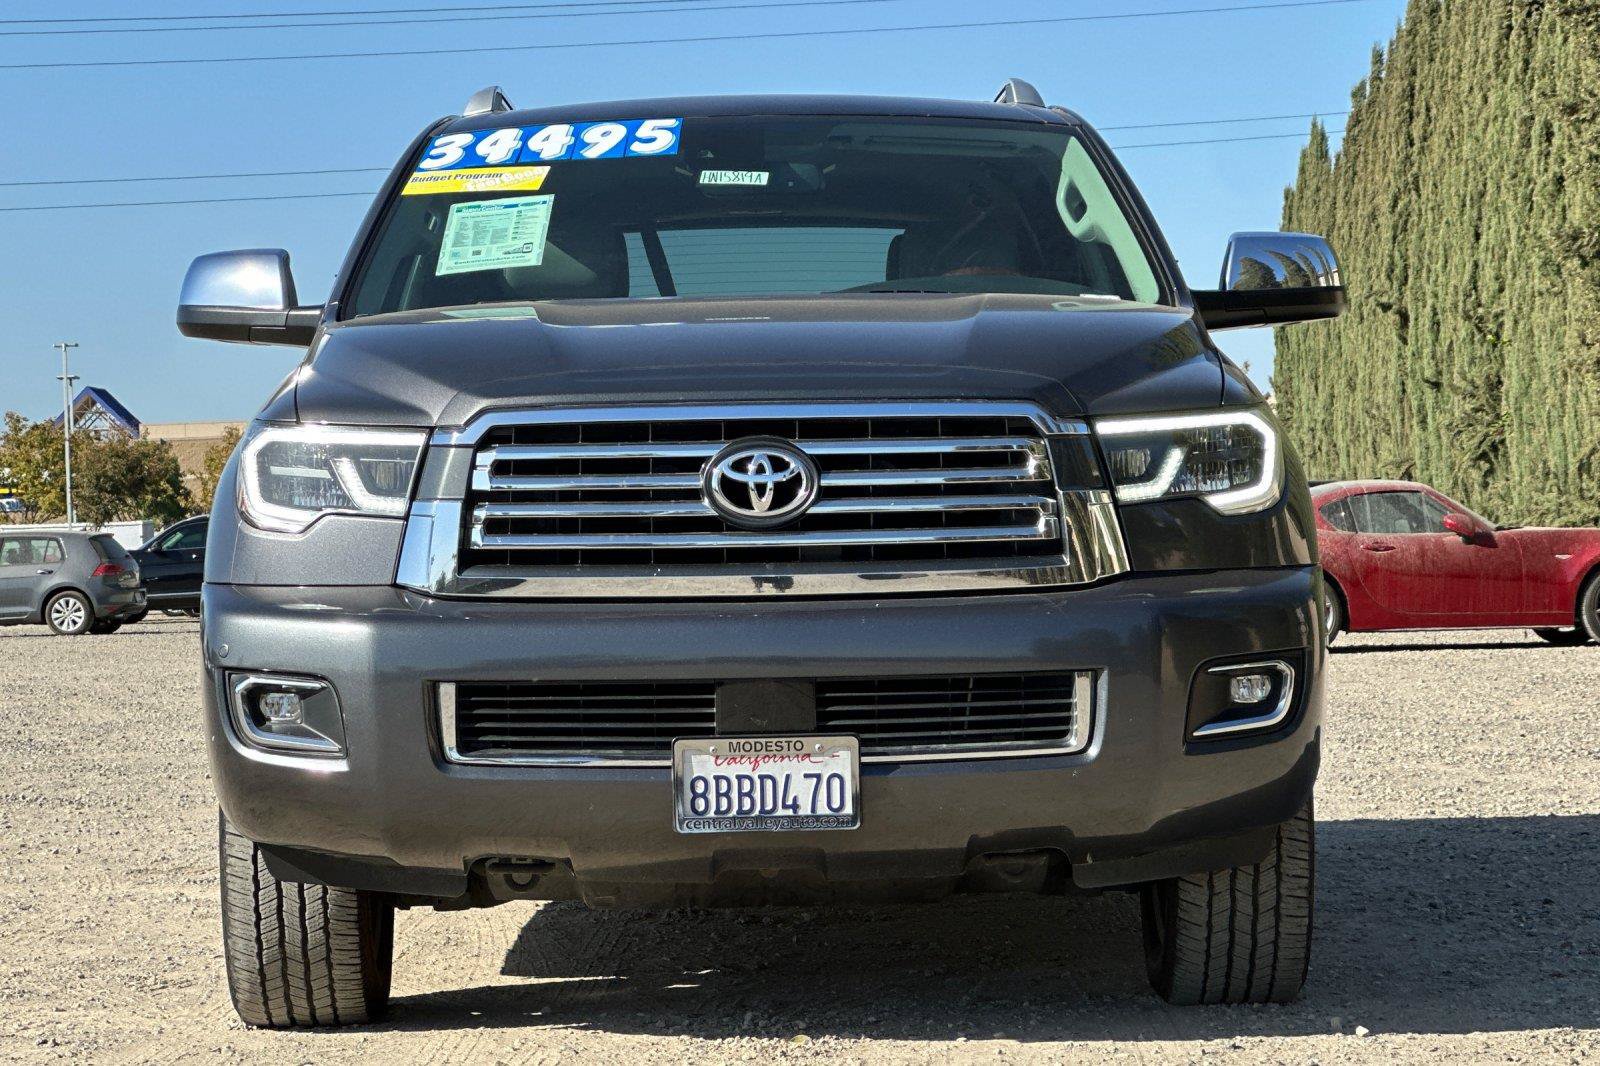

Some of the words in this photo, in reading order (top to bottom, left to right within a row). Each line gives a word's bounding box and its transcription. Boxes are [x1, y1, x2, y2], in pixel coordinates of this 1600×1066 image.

[419, 119, 680, 170] 34495
[411, 174, 452, 183] Budget
[454, 172, 503, 180] Program
[728, 740, 804, 753] MODESTO
[689, 772, 845, 815] 8BBD470
[685, 815, 852, 832] centralvalleyauto.com
